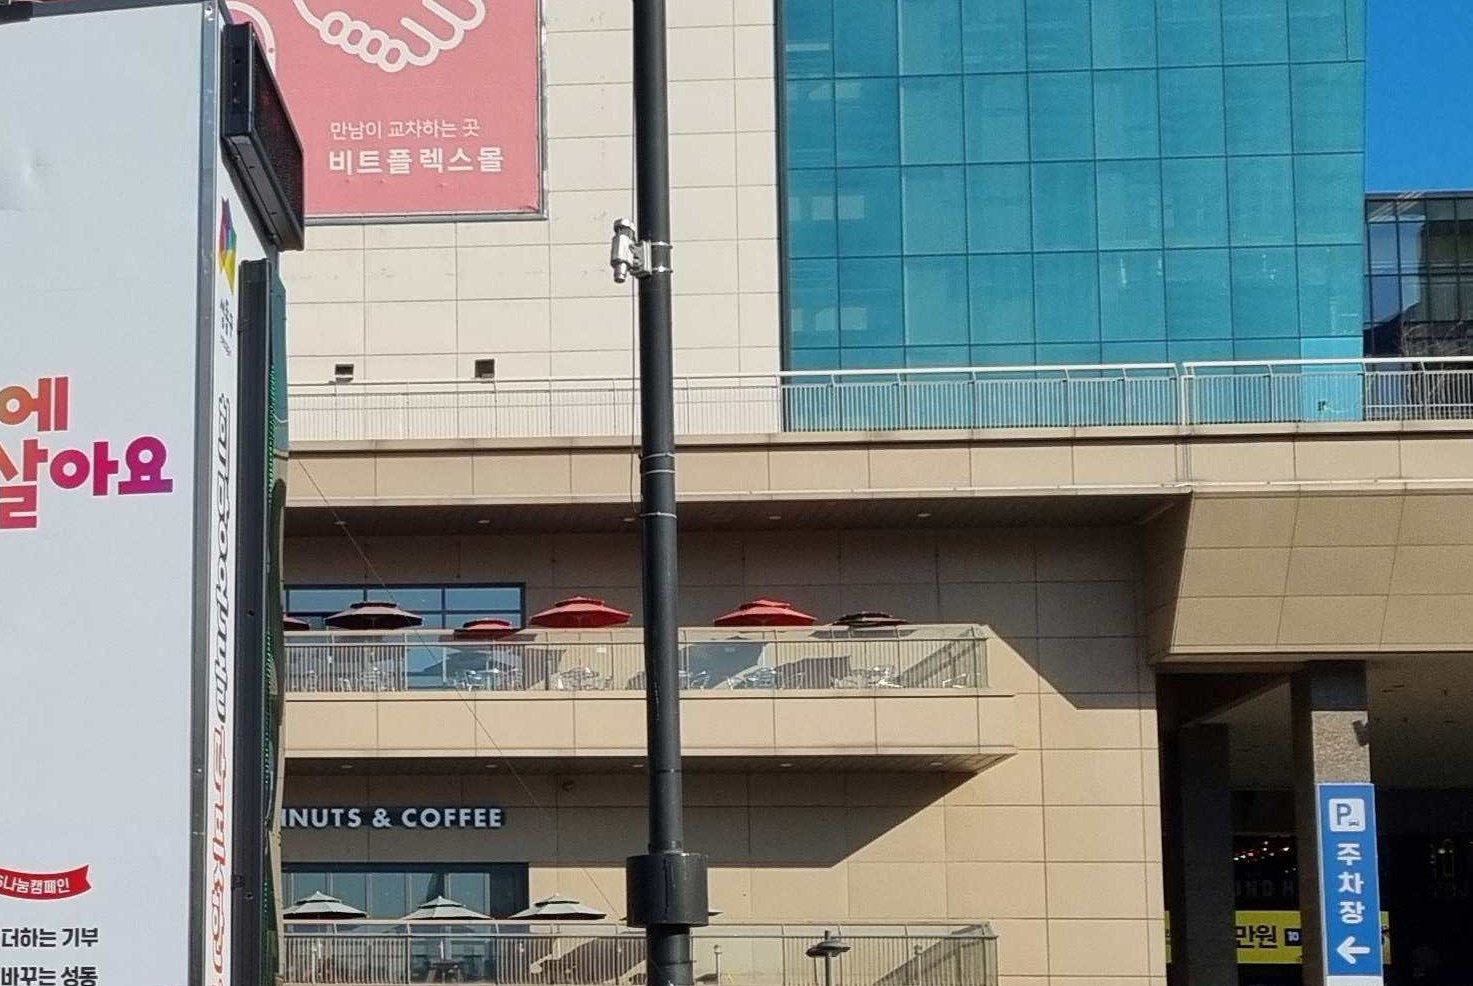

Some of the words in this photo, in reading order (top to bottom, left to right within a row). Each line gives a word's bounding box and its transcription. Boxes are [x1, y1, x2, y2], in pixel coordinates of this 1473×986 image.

[330, 121, 382, 140] 만남이
[387, 119, 457, 139] 교차하는
[462, 118, 481, 137] 곳
[328, 147, 505, 175] 비트플렉스몰
[281, 808, 362, 828] NUTS
[372, 808, 392, 828] &
[402, 808, 502, 828] COFFEE
[1337, 843, 1366, 924] 주차장
[1, 927, 57, 948] 더하는
[62, 927, 99, 948] 기부
[1, 966, 57, 986] 바꾸는
